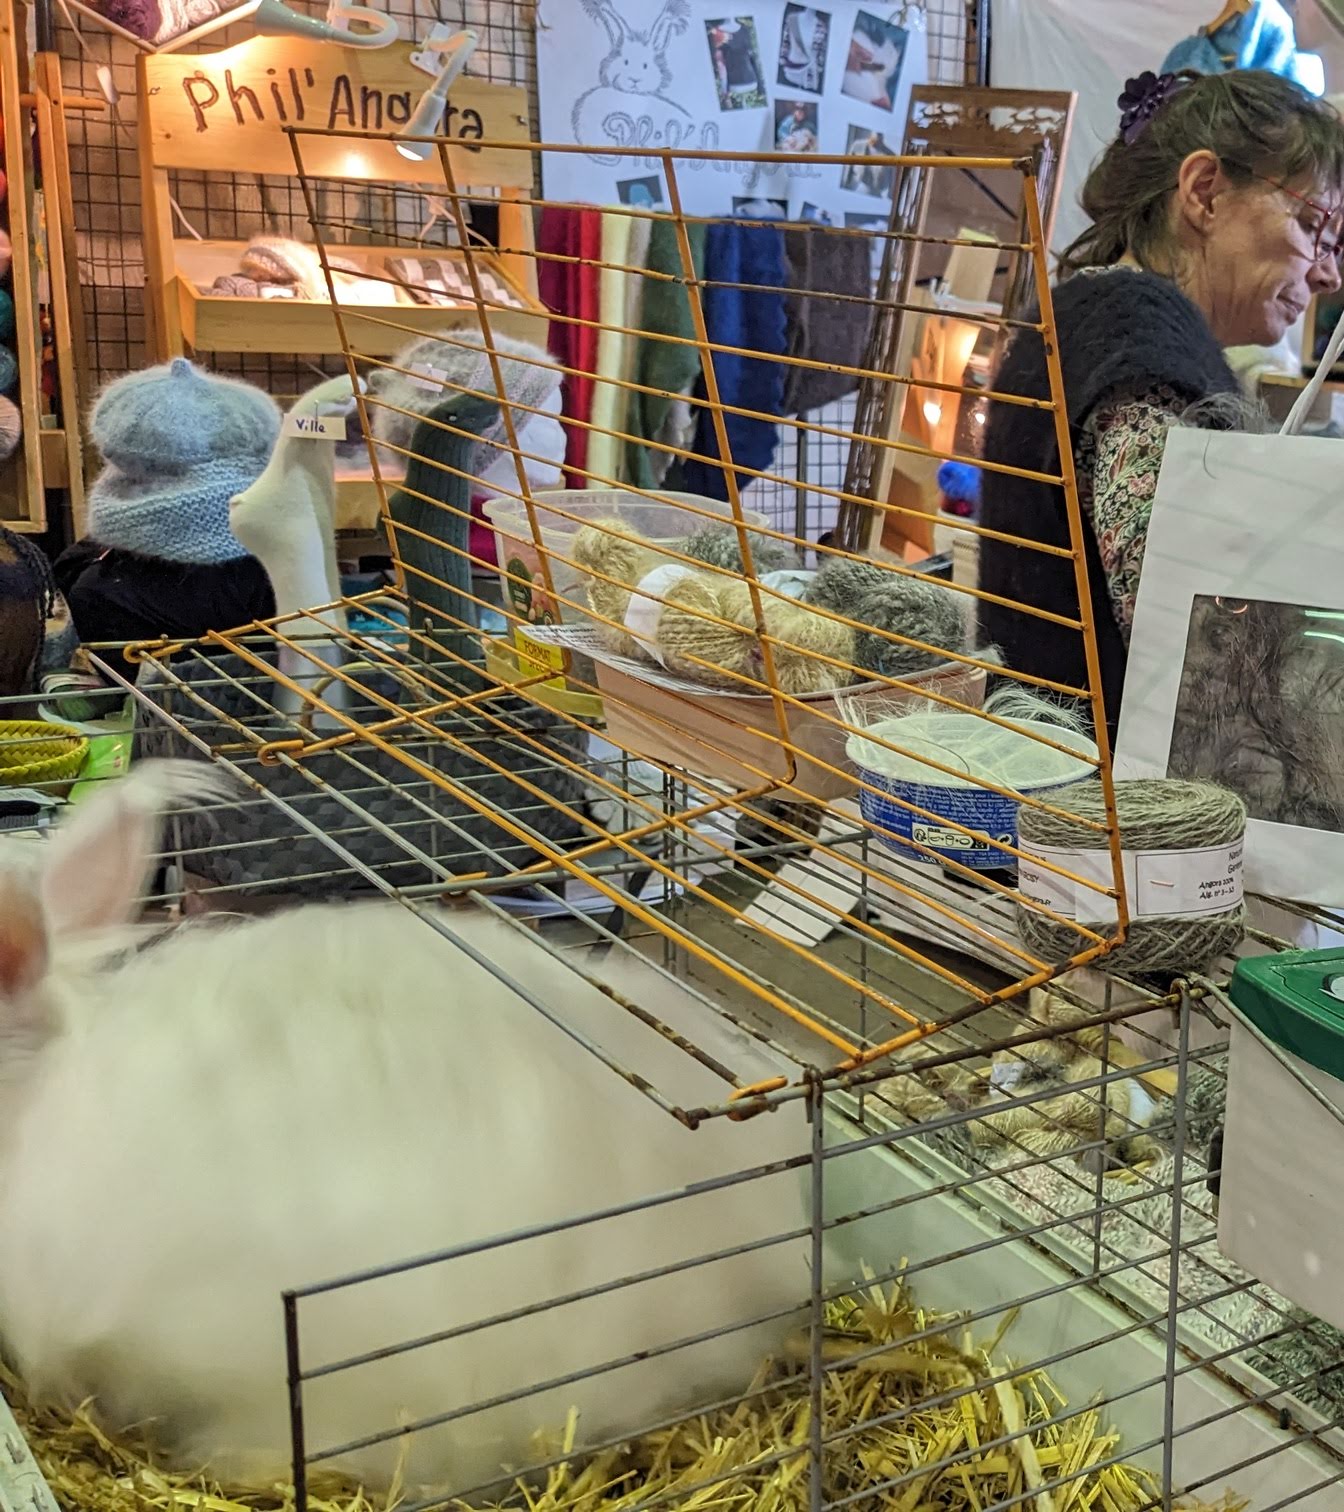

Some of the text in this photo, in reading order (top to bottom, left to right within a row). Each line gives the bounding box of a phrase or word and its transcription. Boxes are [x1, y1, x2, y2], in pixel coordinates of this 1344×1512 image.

[183, 67, 485, 153] Phil'Angra
[296, 418, 326, 433] Ville
[1199, 880, 1222, 890] Angora
